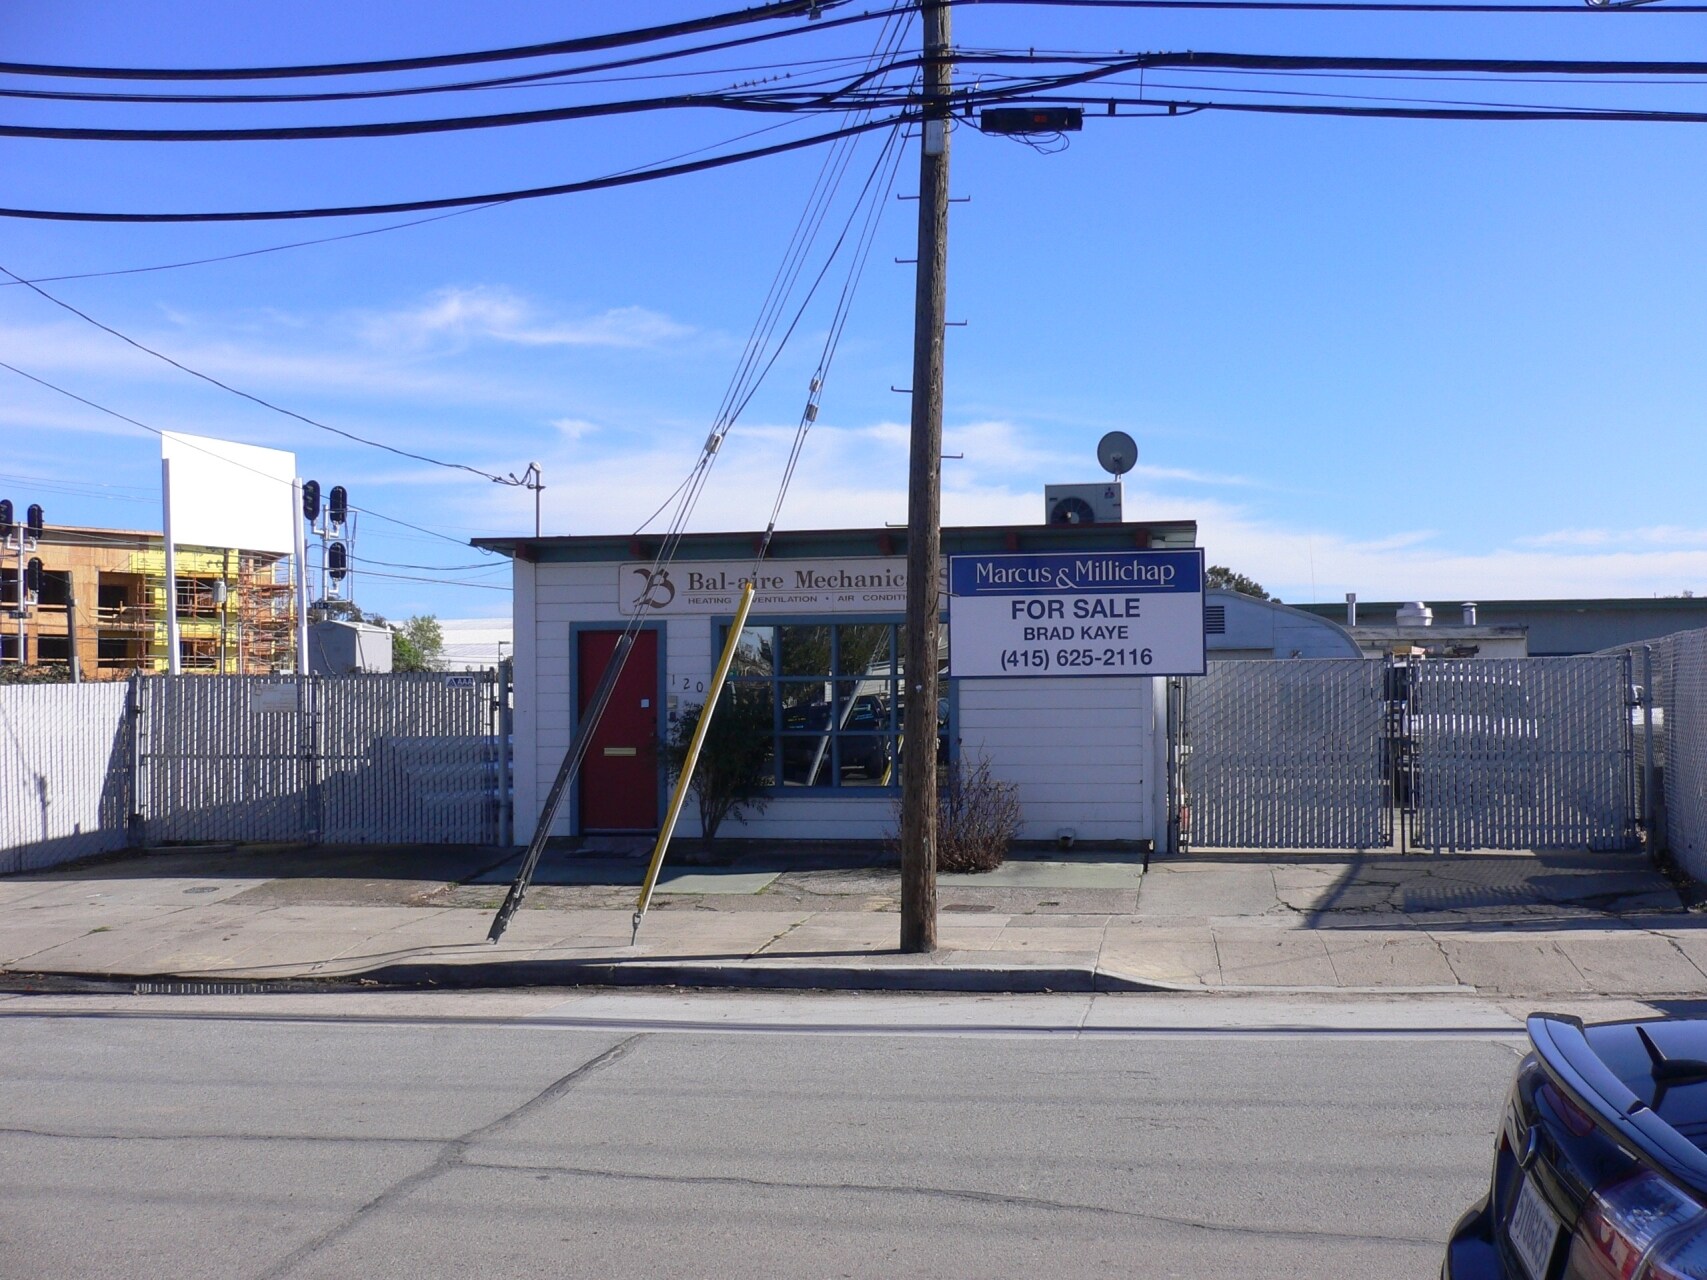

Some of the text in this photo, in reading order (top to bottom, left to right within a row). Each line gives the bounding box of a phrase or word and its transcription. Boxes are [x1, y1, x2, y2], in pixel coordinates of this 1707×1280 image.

[688, 568, 908, 591] Bal-aire Mechanic
[976, 559, 1175, 589] Marcus & Millichap
[688, 597, 732, 605] HEATING
[837, 594, 855, 602] AIR
[1011, 598, 1141, 620] FOR SALE
[1023, 625, 1129, 641] BRAD KAYE
[1001, 648, 1153, 671] (415) 625-2116
[672, 674, 704, 693] 120
